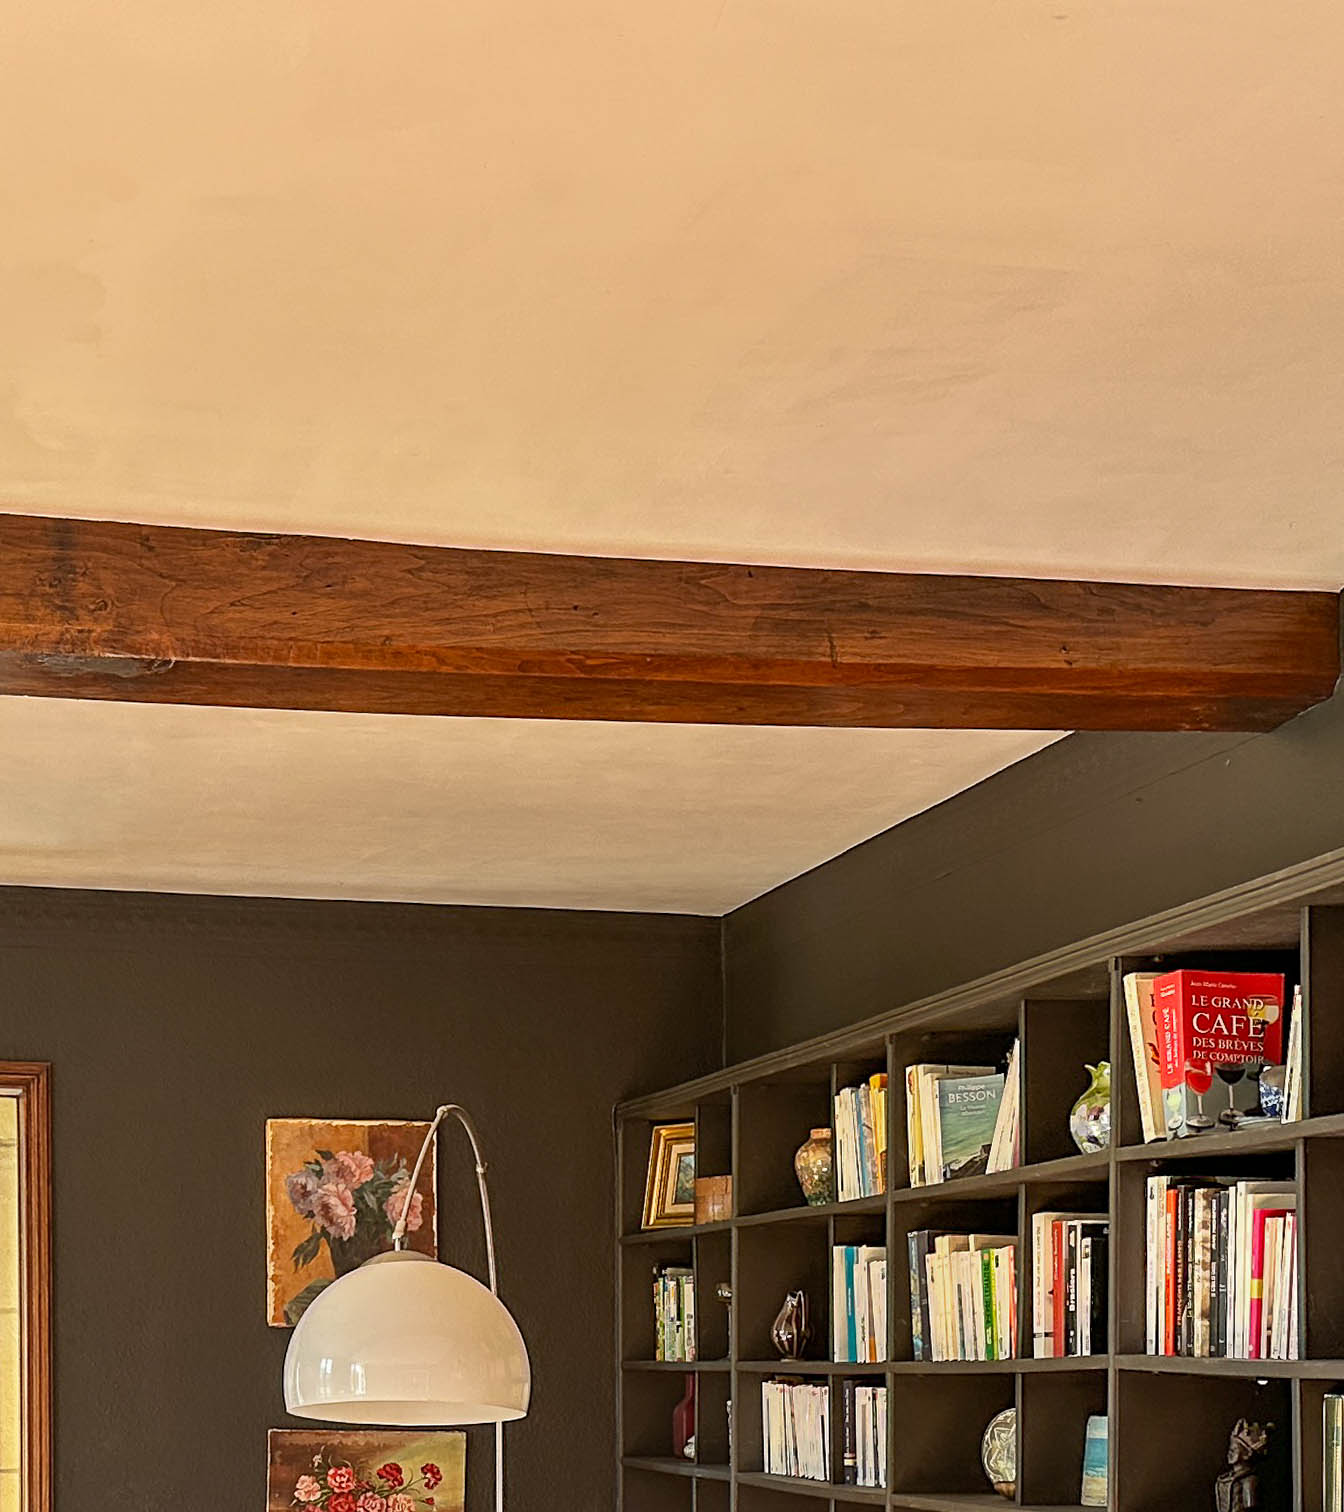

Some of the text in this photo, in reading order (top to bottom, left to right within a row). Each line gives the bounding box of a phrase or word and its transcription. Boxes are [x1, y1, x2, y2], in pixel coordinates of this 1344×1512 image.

[1191, 994, 1264, 1010] LE GRAND
[1192, 1011, 1264, 1038] CAFÉ
[1192, 1037, 1264, 1053] DES BRÈVES
[1192, 1050, 1264, 1065] DE COMPTOIR
[948, 1090, 996, 1104] BESSON
